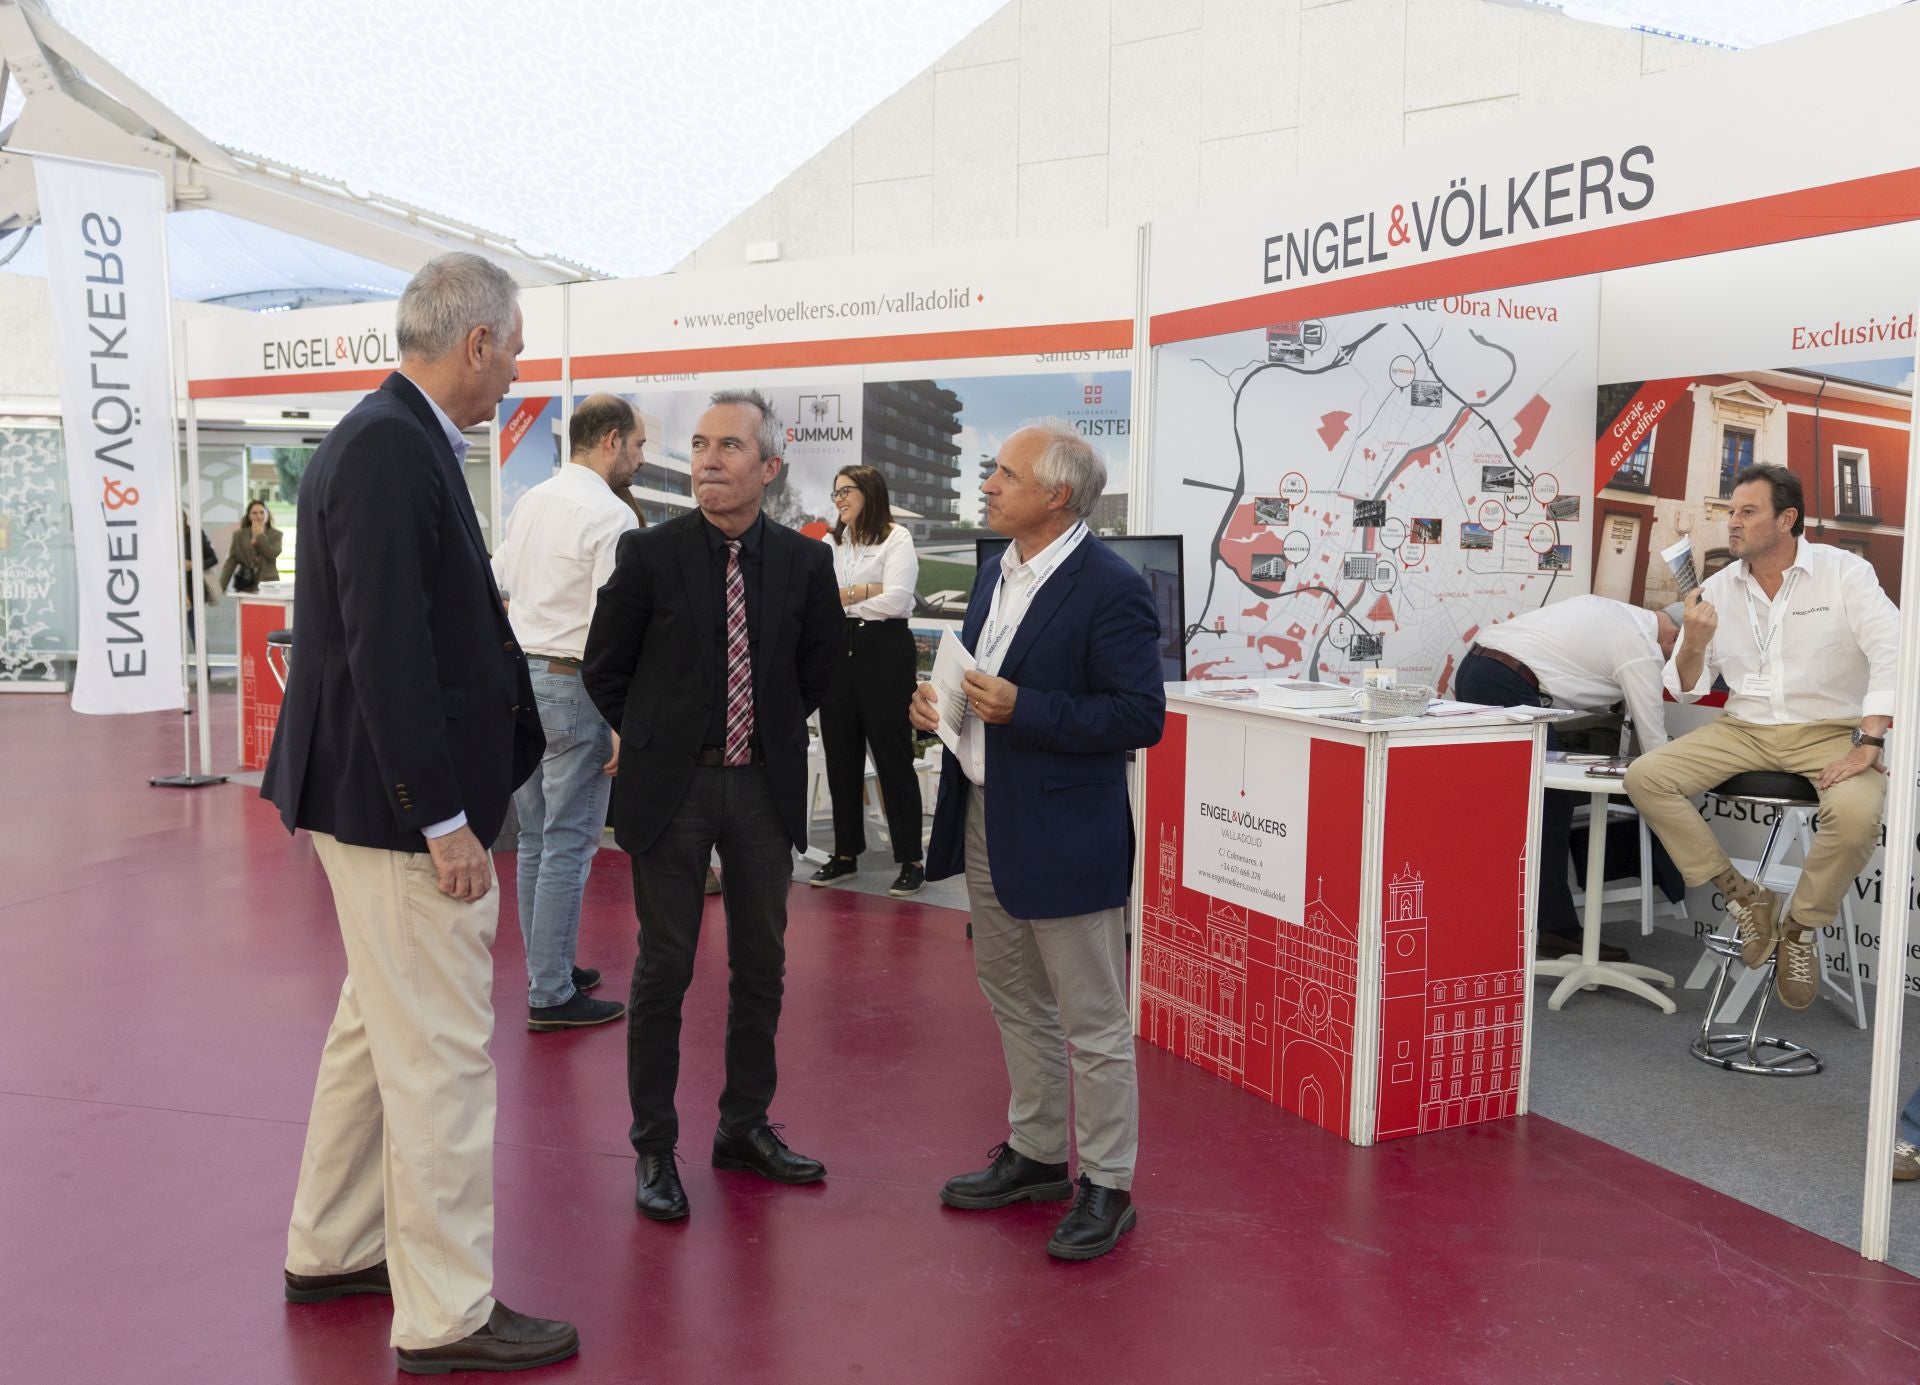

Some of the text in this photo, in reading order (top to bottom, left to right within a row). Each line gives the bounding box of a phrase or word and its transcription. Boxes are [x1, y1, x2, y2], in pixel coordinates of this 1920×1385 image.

[1264, 145, 1654, 284] ENGEL&VÖLKERS
[684, 287, 970, 329] www.engelvoelkers.com/valladolid
[1443, 296, 1490, 317] Obra
[1497, 298, 1558, 322] Nueva
[264, 328, 400, 369] ENGEL&VÖL
[786, 426, 853, 443] SUMMUM
[1610, 399, 1666, 466] en el edificio
[1613, 401, 1645, 438] Garaje
[1200, 802, 1287, 838] ENGEL&VÖLKERS
[1221, 828, 1263, 848] VALLADOLID
[1198, 869, 1286, 903] www.engelvoelkers.com/valladolid
